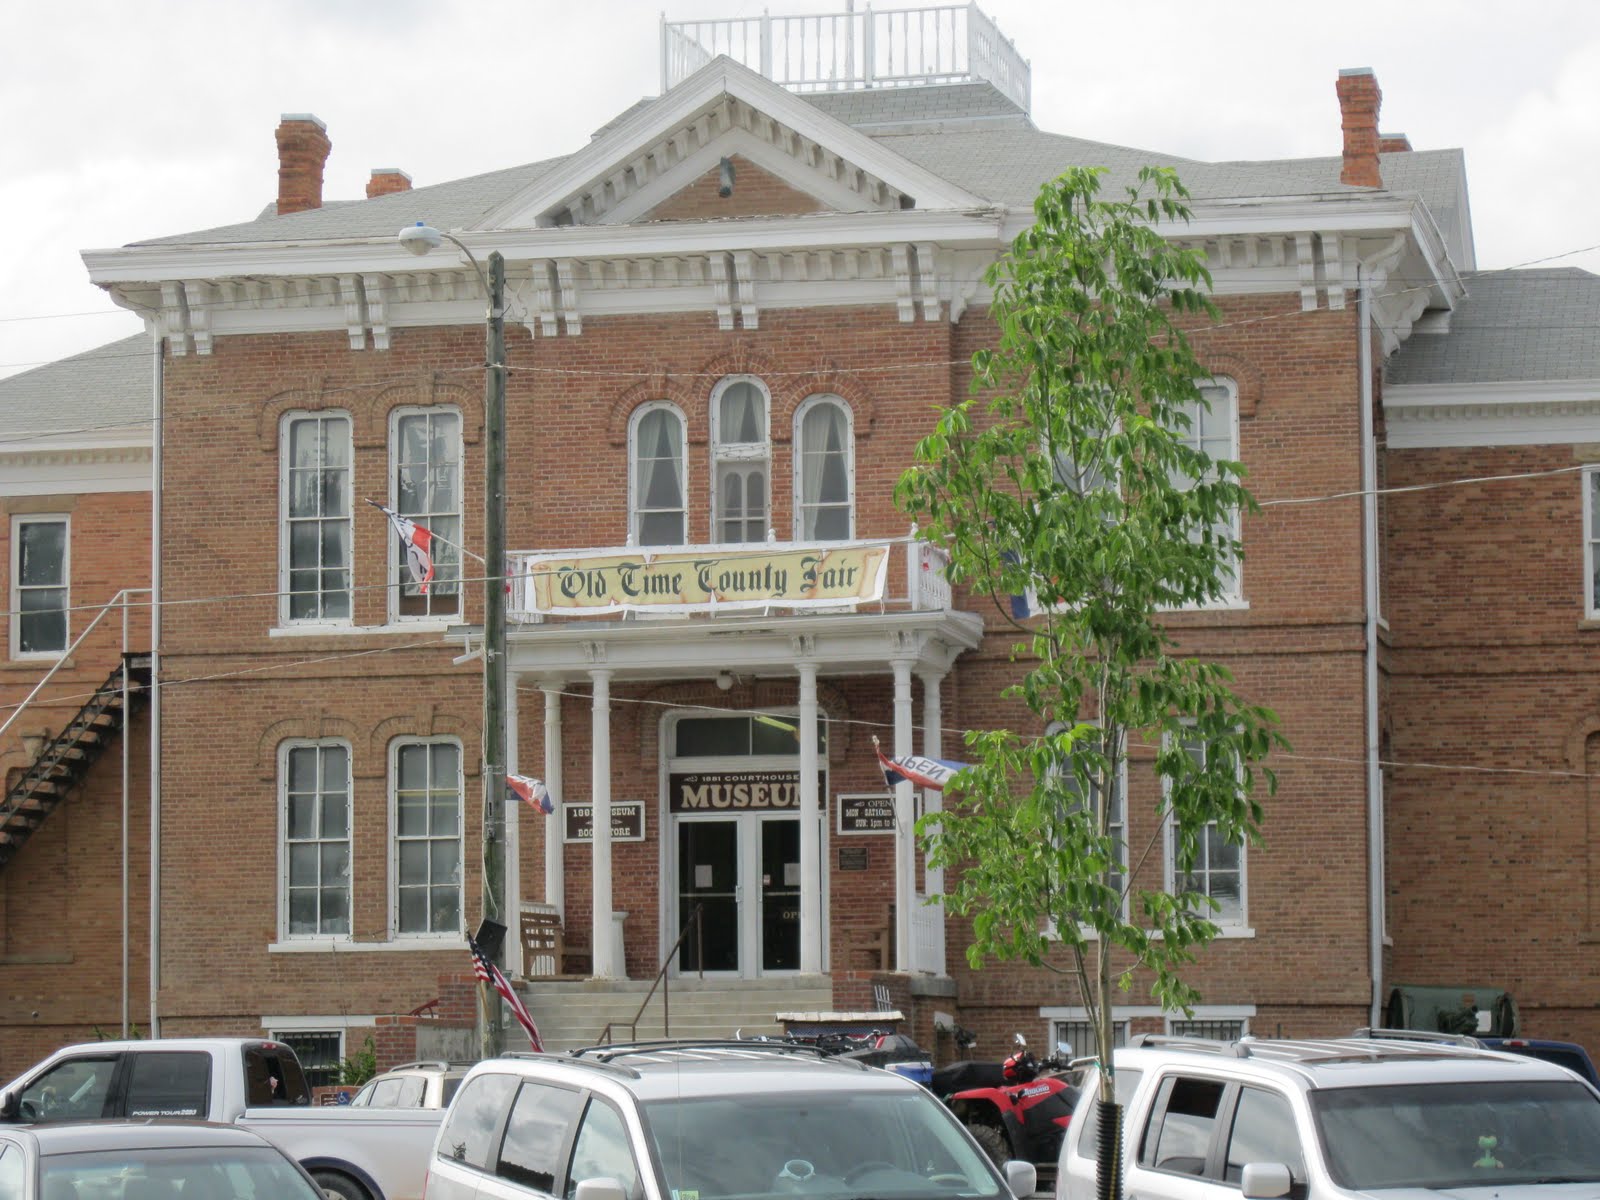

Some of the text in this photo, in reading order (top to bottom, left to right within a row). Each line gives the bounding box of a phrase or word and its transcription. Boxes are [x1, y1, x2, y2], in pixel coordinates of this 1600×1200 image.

[557, 556, 859, 598] Old Time County Fair
[724, 773, 800, 782] COURTHOUSE
